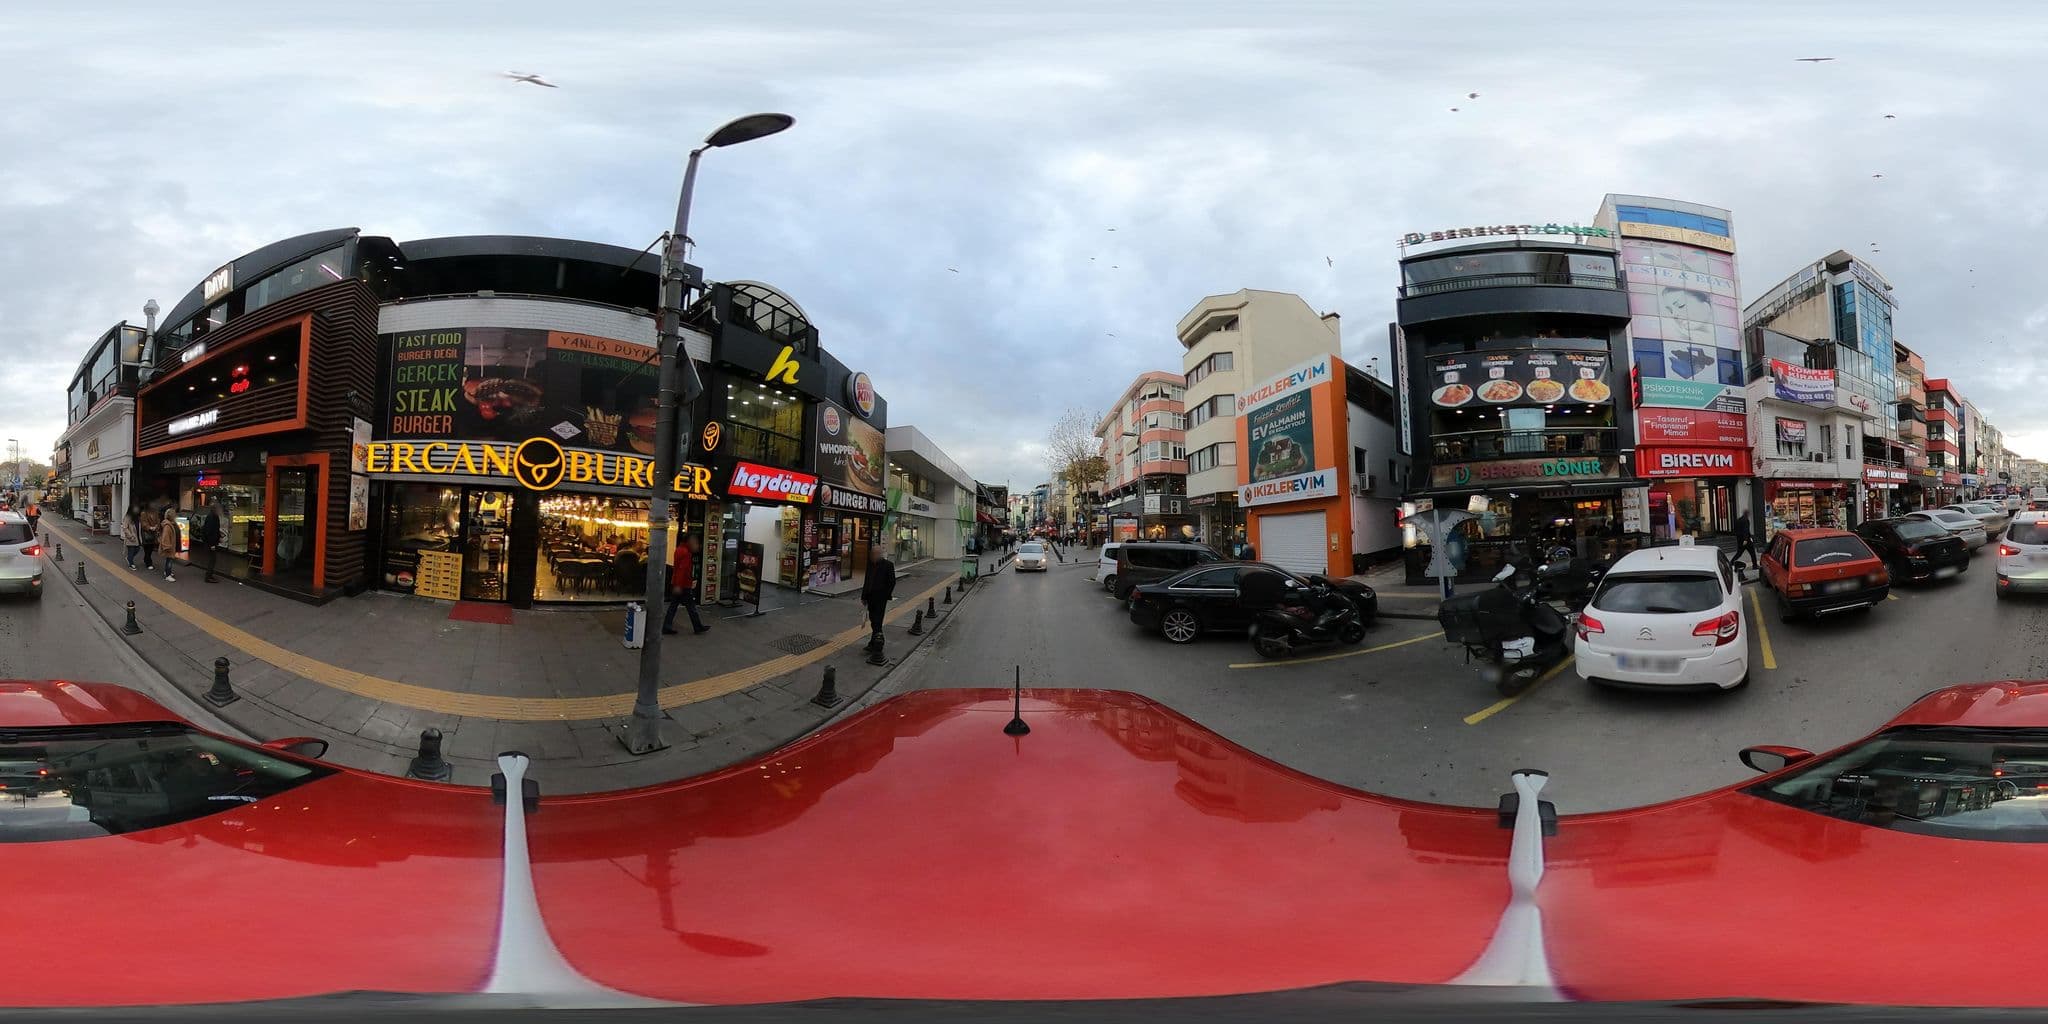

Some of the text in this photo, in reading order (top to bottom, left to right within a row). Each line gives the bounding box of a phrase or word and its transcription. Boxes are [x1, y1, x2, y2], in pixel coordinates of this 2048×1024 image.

[204, 269, 228, 299] DAYI
[399, 333, 462, 348] FAST FOOD
[398, 350, 432, 361] BURGER
[765, 345, 799, 384] h
[397, 363, 459, 384] GERÇEK
[395, 388, 458, 412] STEAK
[393, 414, 453, 433] BURGER
[1252, 410, 1306, 441] EV ALMANIN
[1656, 415, 1688, 423] Tasarruf
[366, 442, 511, 476] ERCAN
[1543, 458, 1600, 476] DÖNER
[1661, 453, 1733, 468] BİREVİM
[734, 466, 817, 496] heydöner
[832, 489, 886, 513] BURGER KING
